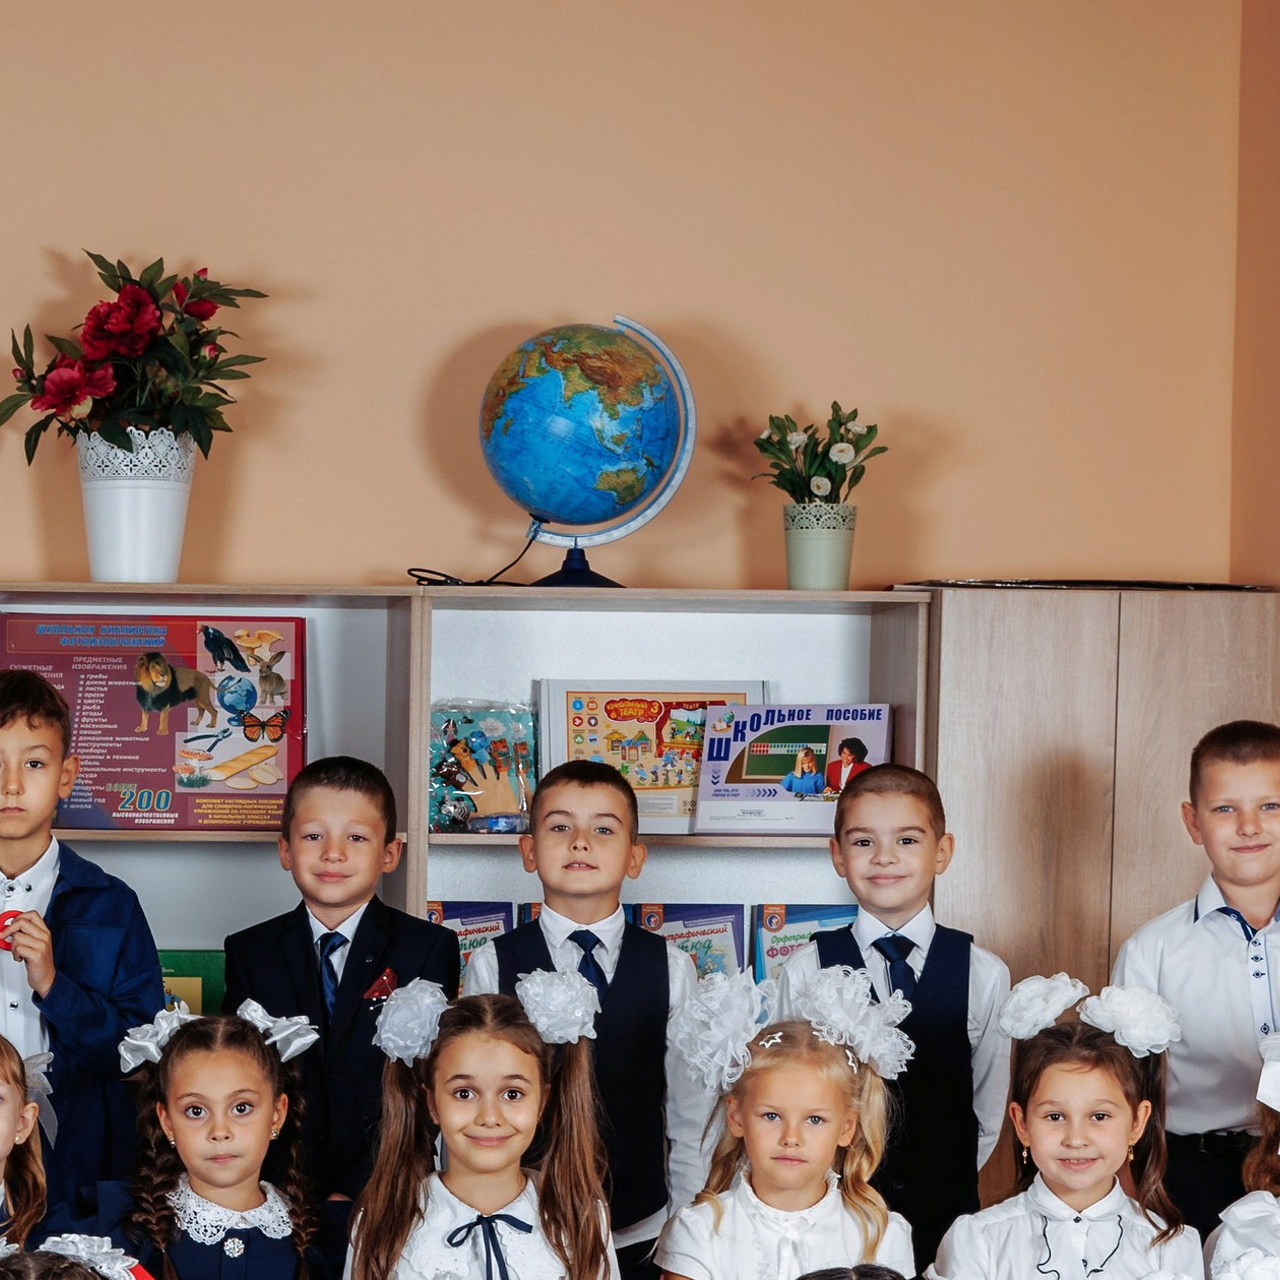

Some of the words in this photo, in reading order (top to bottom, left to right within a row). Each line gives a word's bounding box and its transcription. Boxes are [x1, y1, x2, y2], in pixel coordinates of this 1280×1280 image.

[36, 624, 95, 635] ШКОЛЬНАЯ
[100, 625, 167, 636] БИБЛИОТЕКА
[60, 636, 165, 647] ФОТОИЗОБРАЖЕНИЙ
[620, 707, 644, 716] ТЕАТР
[651, 702, 659, 714] 3
[707, 709, 812, 762] ШКОЛЬНОЕ
[826, 708, 882, 721] ПОСОБИЕ
[118, 789, 172, 811] 200
